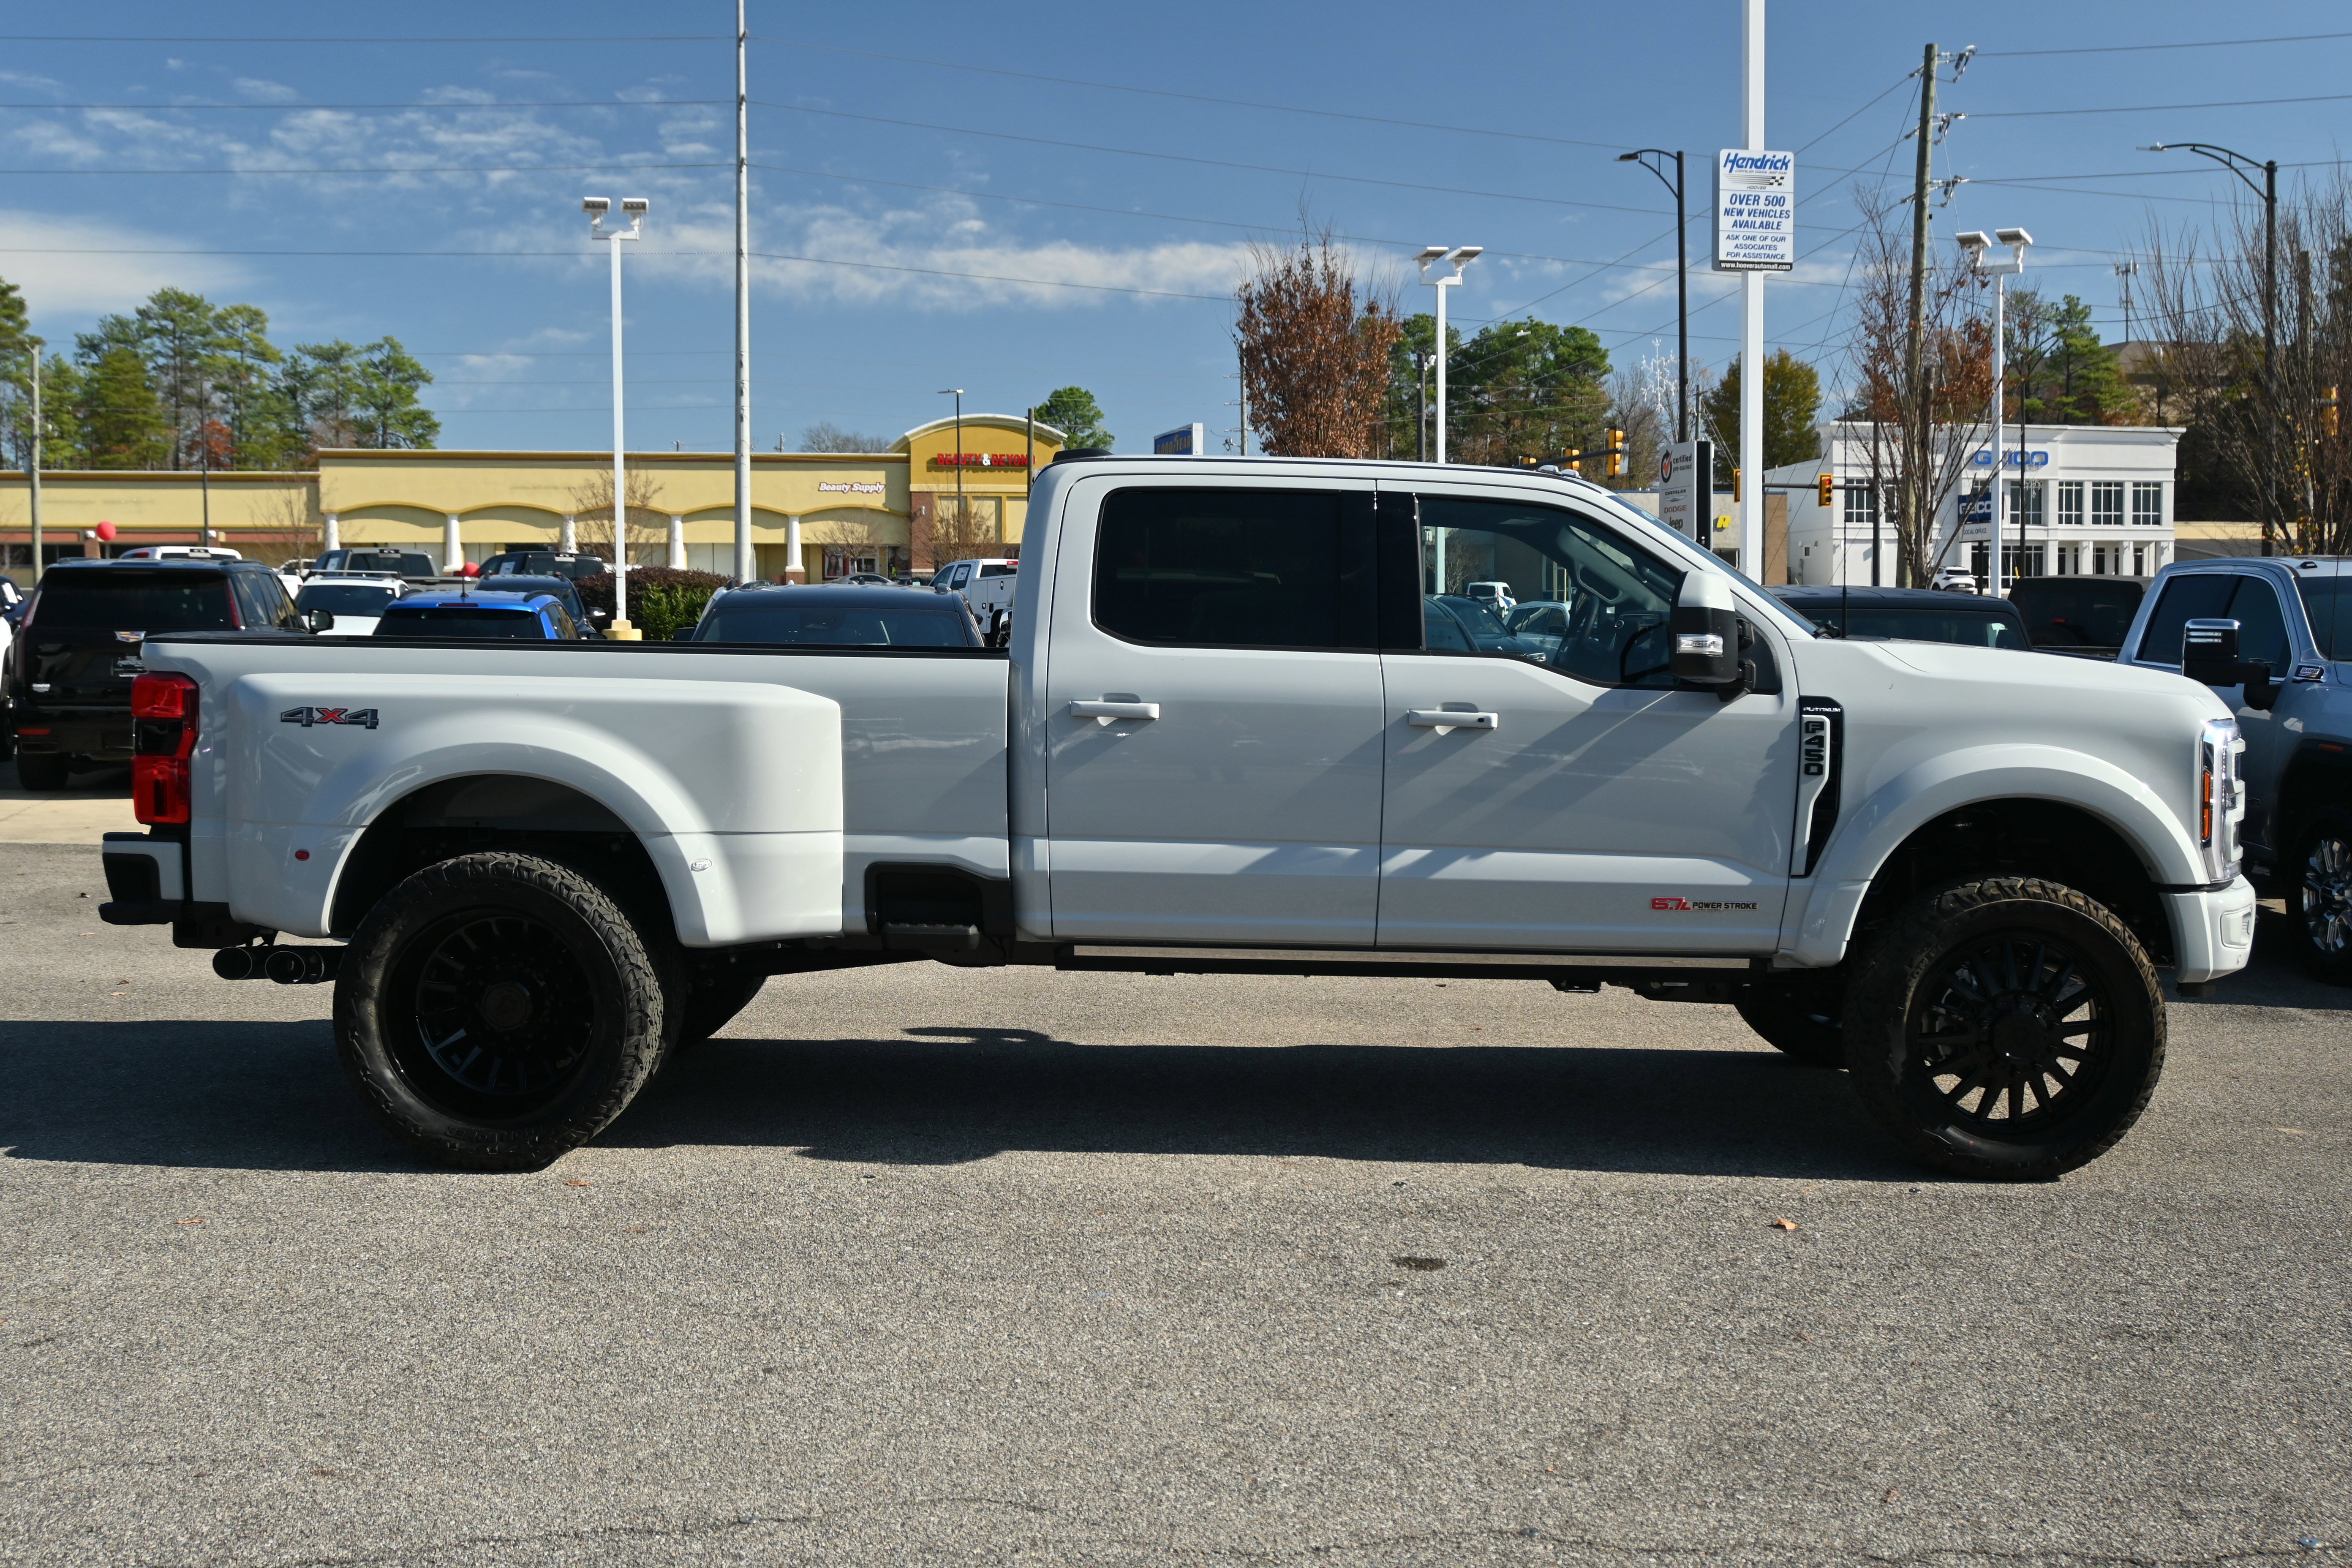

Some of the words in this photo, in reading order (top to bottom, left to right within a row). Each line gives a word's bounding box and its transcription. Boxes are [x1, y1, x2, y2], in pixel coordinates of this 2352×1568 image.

[1723, 152, 1791, 173] Hendrick
[1730, 193, 1761, 206] OVER
[1764, 195, 1786, 207] 500
[1723, 207, 1745, 217] NEW
[1748, 208, 1791, 219] VEHICLES
[1731, 219, 1782, 230] AVAILABLE
[1720, 261, 1791, 270] www.hooverautomall.com
[937, 453, 981, 466] BEAUTY
[982, 453, 991, 466] &
[991, 453, 1036, 466] BEYON
[1673, 453, 1692, 464] certified
[1974, 450, 2049, 466] GICO
[1673, 464, 1692, 473] pre-owned
[818, 482, 852, 494] Beauty
[851, 482, 886, 494] Supply
[1664, 505, 1687, 514] DODGE
[1669, 516, 1683, 531] Jeep
[1804, 721, 1824, 776] F450
[1651, 897, 1691, 911] 6.7L
